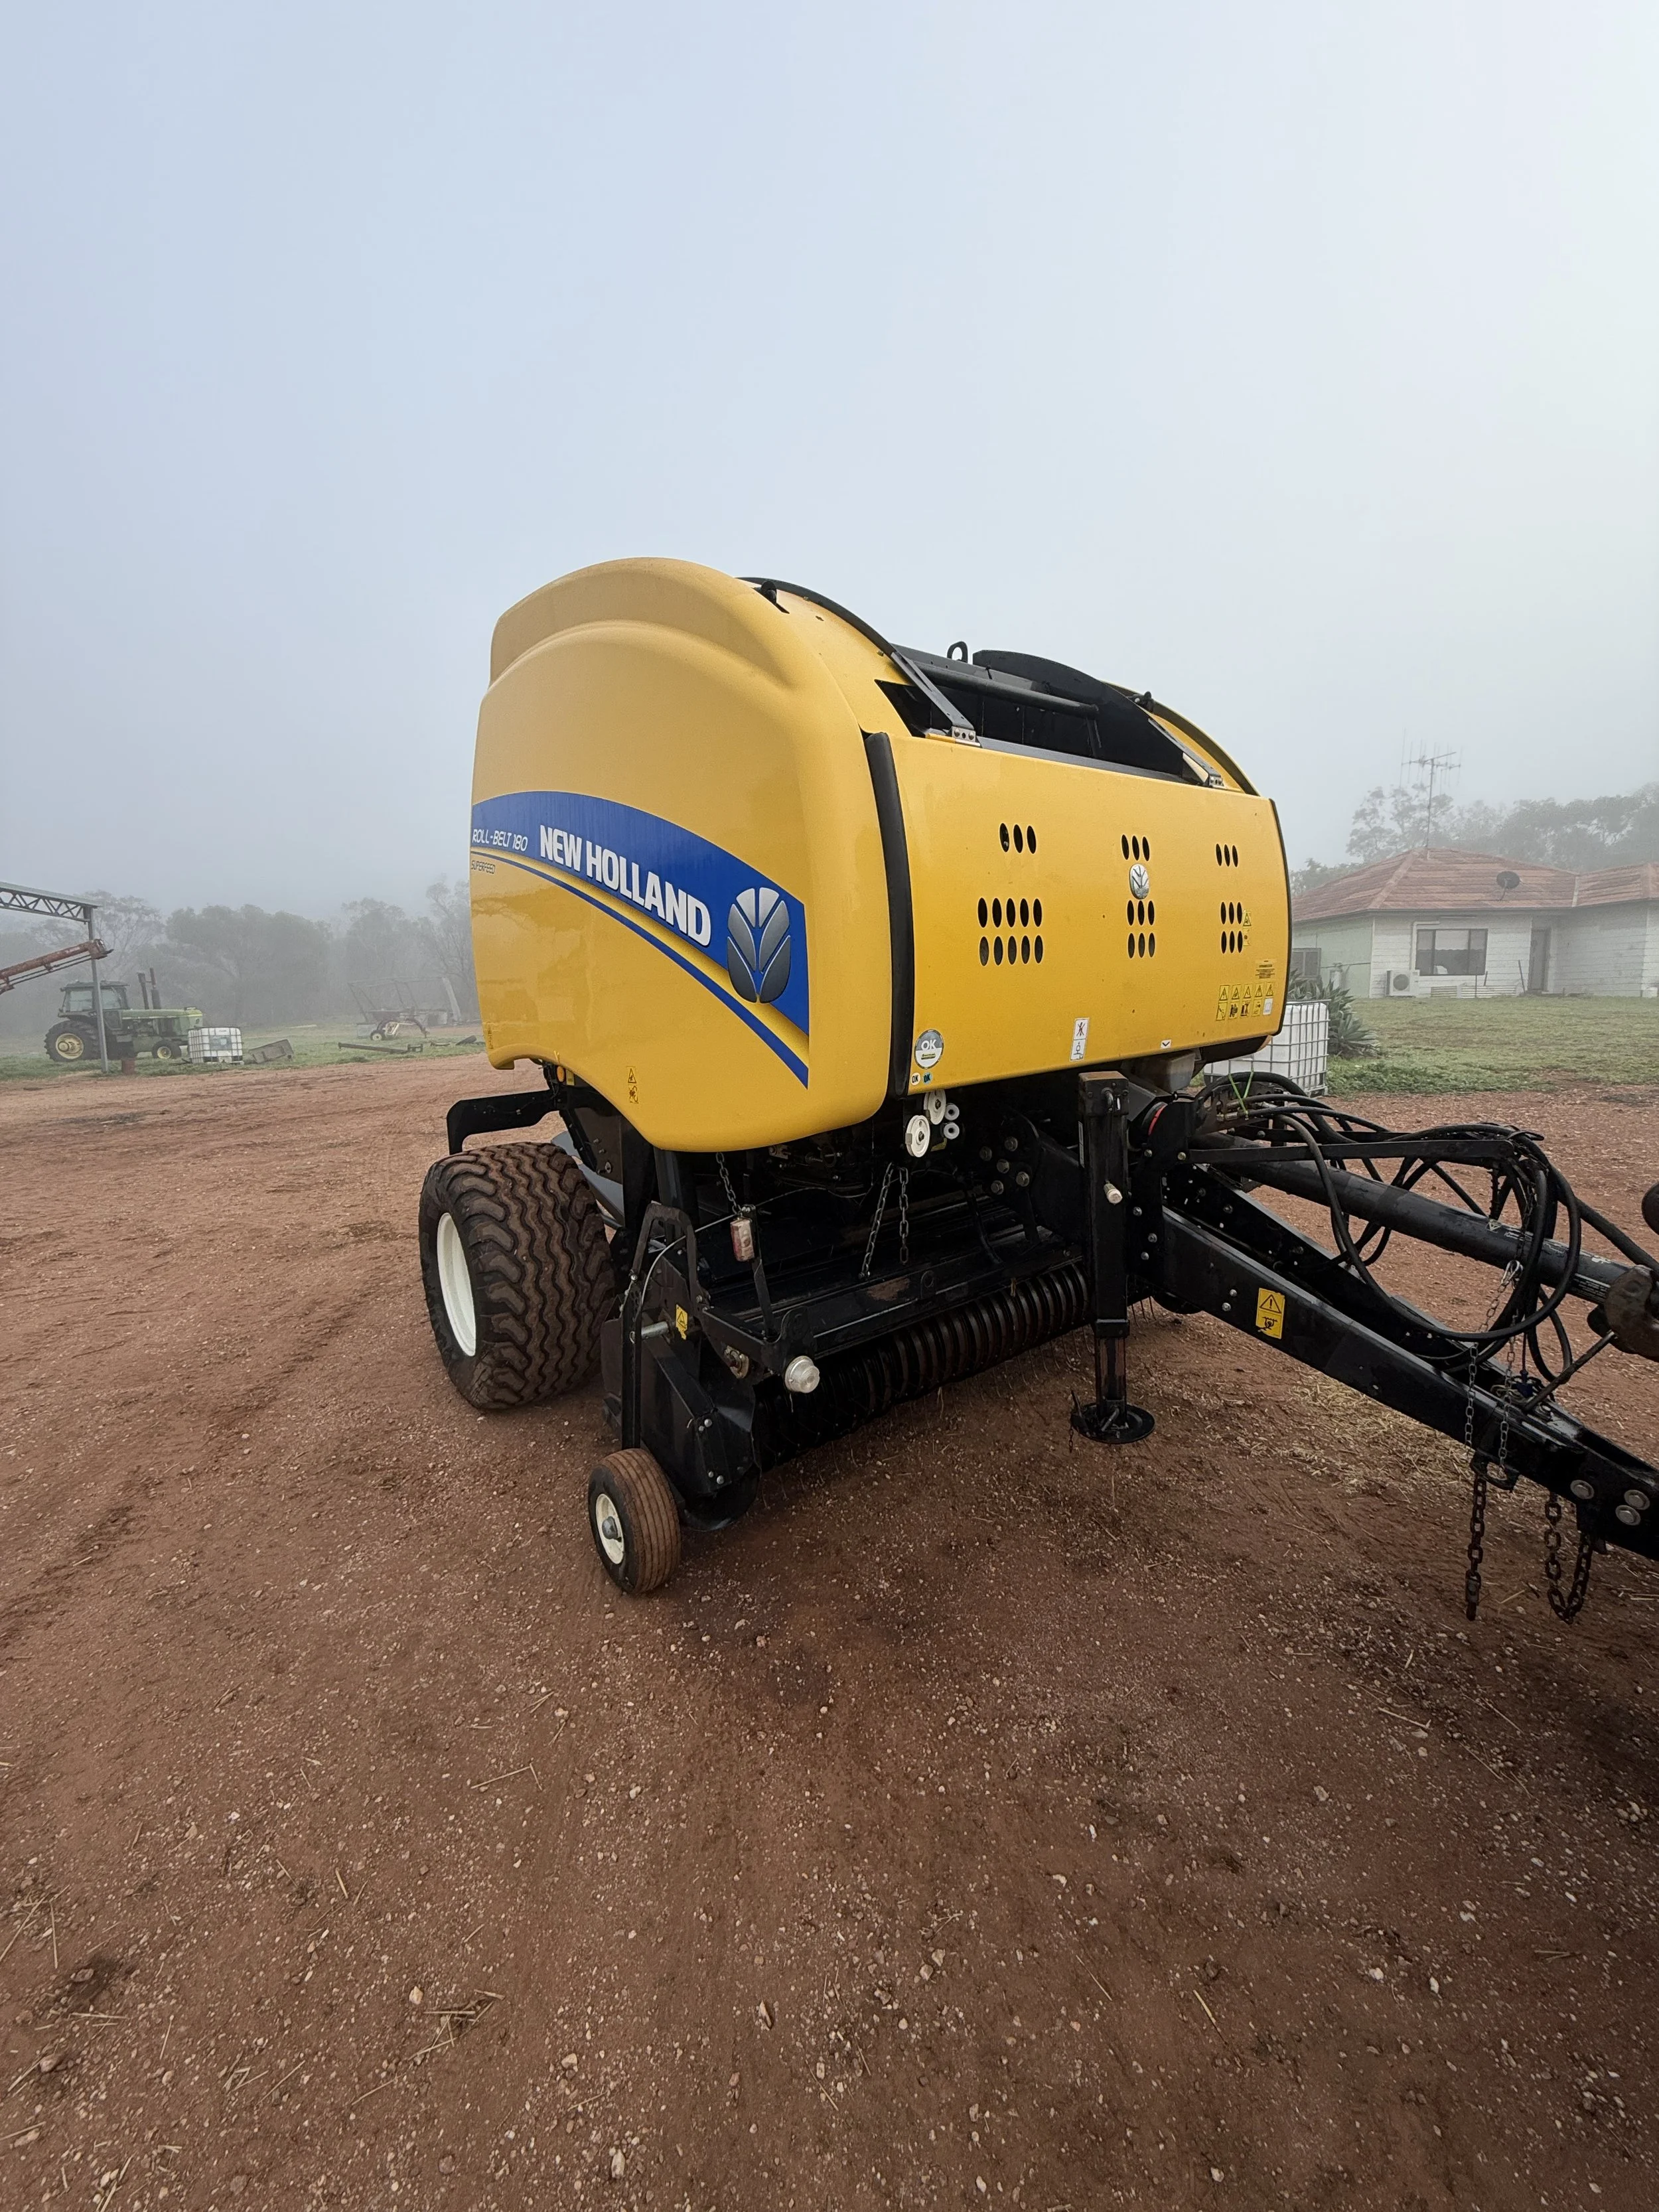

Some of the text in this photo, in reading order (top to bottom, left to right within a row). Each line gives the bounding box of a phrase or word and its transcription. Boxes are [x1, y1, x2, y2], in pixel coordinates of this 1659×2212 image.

[472, 828, 528, 852] ROLL-BELT 180
[540, 824, 711, 947] NEW HOLLAND
[920, 1039, 937, 1051] OK
[911, 1074, 918, 1084] OK
[923, 1073, 931, 1083] OK
